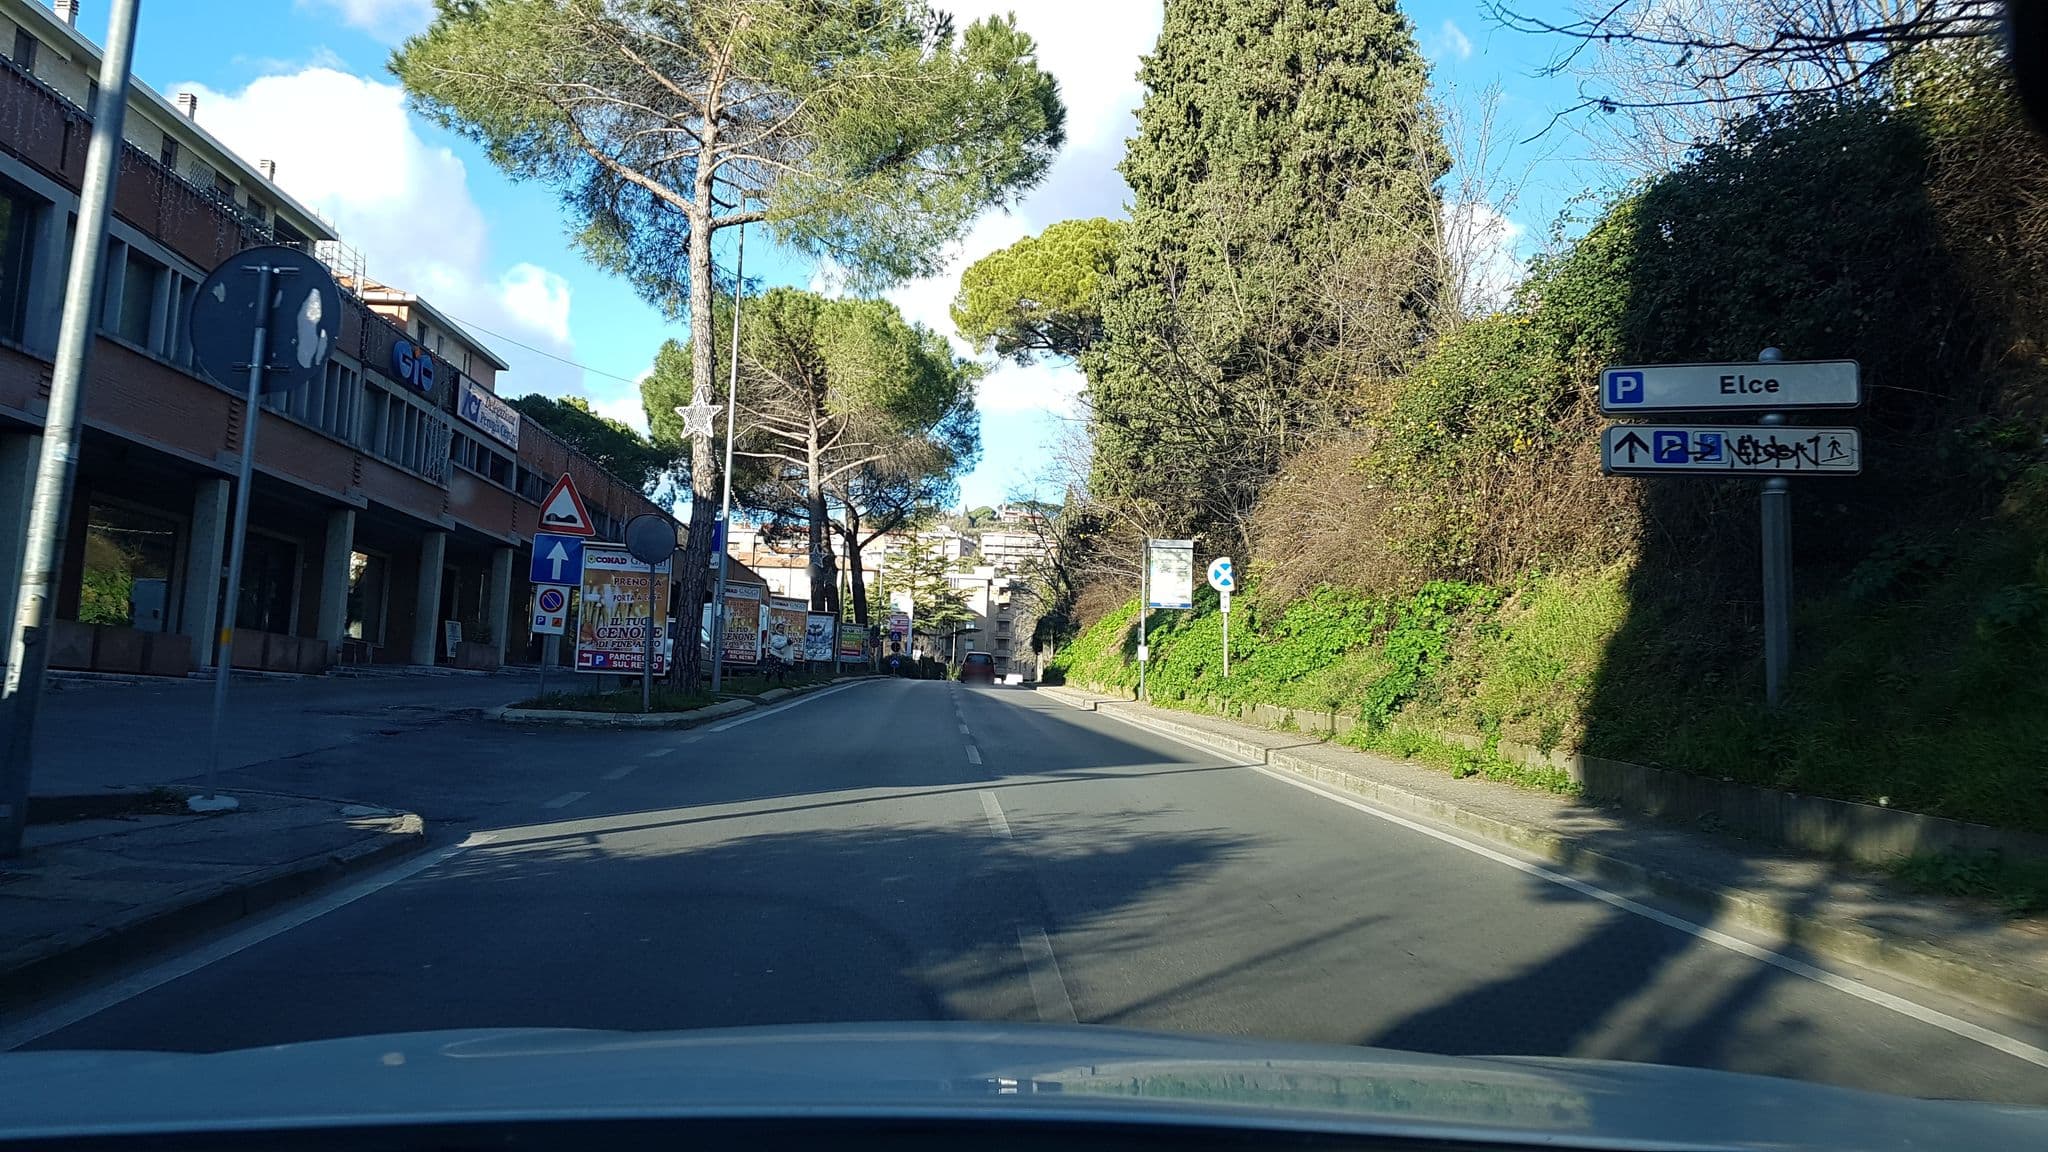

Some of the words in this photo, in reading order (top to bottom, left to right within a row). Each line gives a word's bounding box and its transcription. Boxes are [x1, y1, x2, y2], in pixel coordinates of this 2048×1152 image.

[1616, 376, 1637, 400] P
[1720, 374, 1780, 395] Elce
[596, 556, 627, 565] CONAD
[614, 577, 662, 586] PRENOA
[610, 617, 622, 626] IL
[599, 640, 608, 648] DI
[595, 655, 604, 665] P
[609, 653, 662, 662] PARCHEIO
